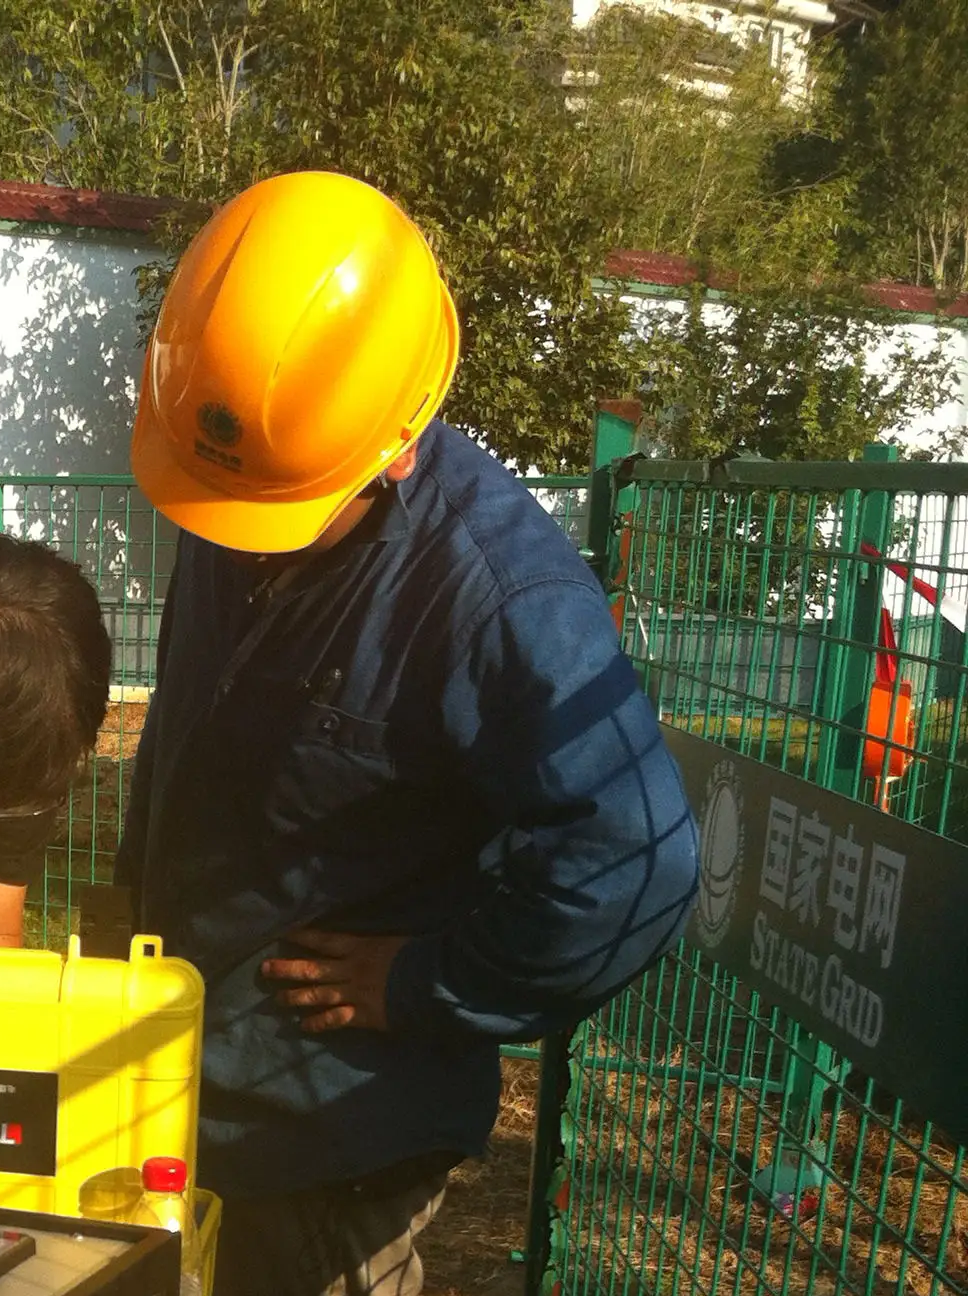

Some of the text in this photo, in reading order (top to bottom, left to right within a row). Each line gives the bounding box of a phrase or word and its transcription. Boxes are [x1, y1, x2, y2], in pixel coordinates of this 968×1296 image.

[760, 797, 907, 969] 国家电网
[750, 910, 883, 1049] STATE GRID
